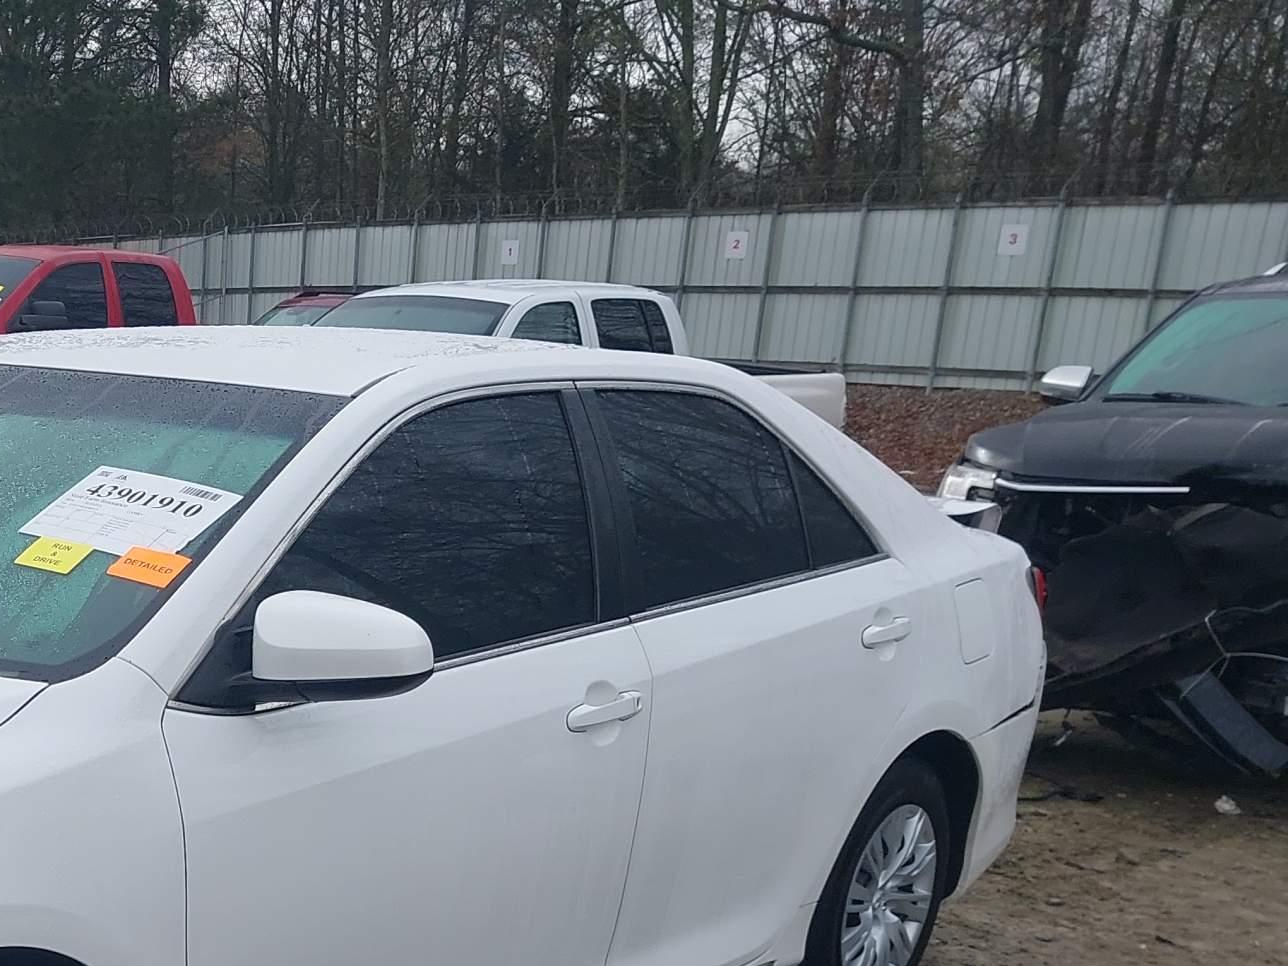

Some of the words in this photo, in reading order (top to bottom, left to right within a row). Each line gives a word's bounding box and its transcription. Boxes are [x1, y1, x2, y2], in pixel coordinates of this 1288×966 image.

[732, 239, 741, 249] 2
[1008, 233, 1018, 245] 3
[86, 483, 203, 518] 43901910
[51, 543, 73, 552] RUN
[33, 556, 63, 567] DRIVE
[123, 558, 174, 575] DETAILED
